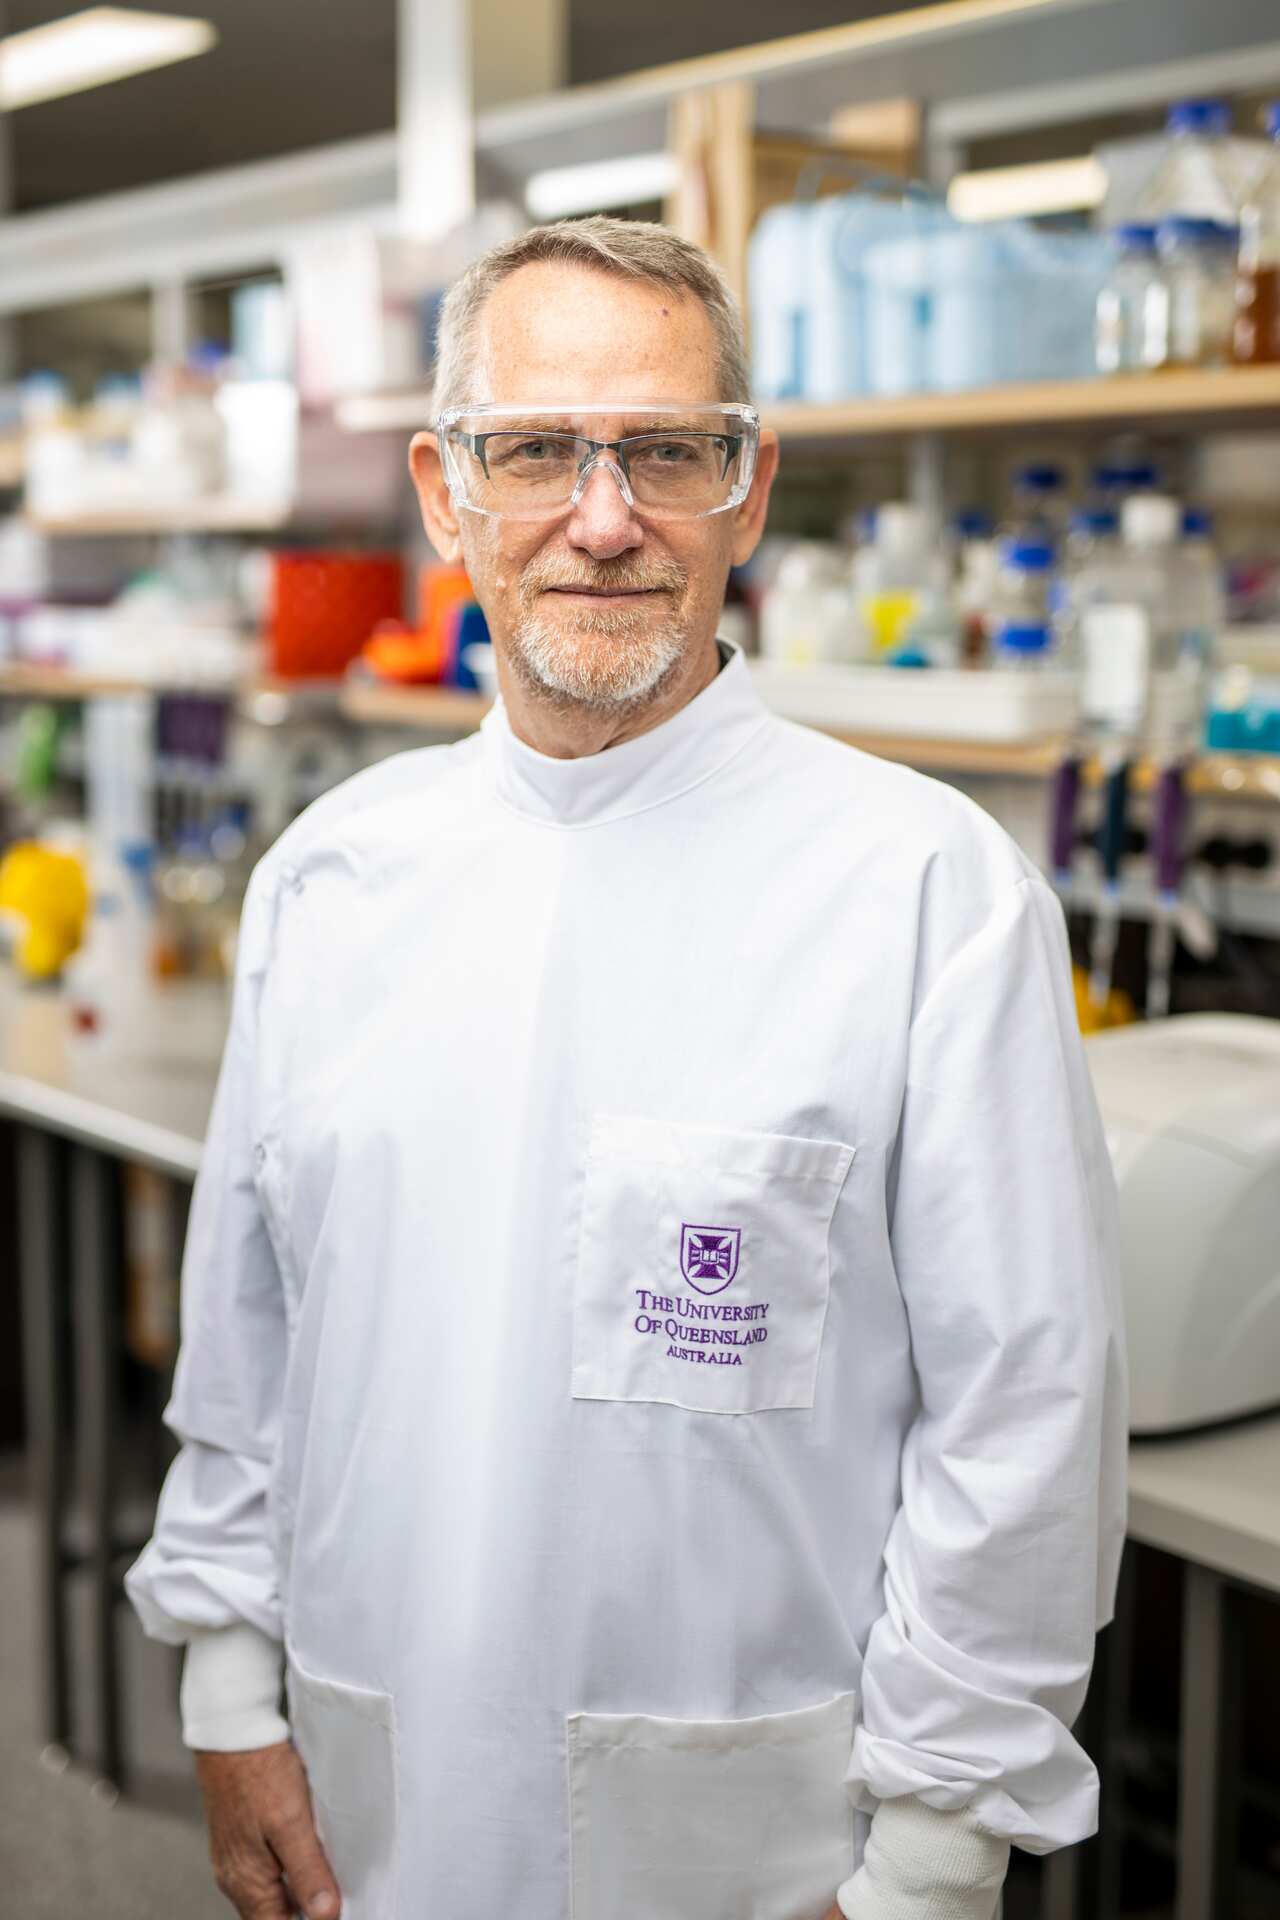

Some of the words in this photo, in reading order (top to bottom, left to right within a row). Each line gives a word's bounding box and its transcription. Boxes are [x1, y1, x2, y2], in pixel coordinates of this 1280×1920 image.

[635, 1289, 674, 1312] THE
[675, 1297, 769, 1321] UNIVERSITY
[634, 1315, 662, 1334] OF
[665, 1318, 768, 1346] QUEENSLAND
[667, 1344, 743, 1365] AUSTRALIA
